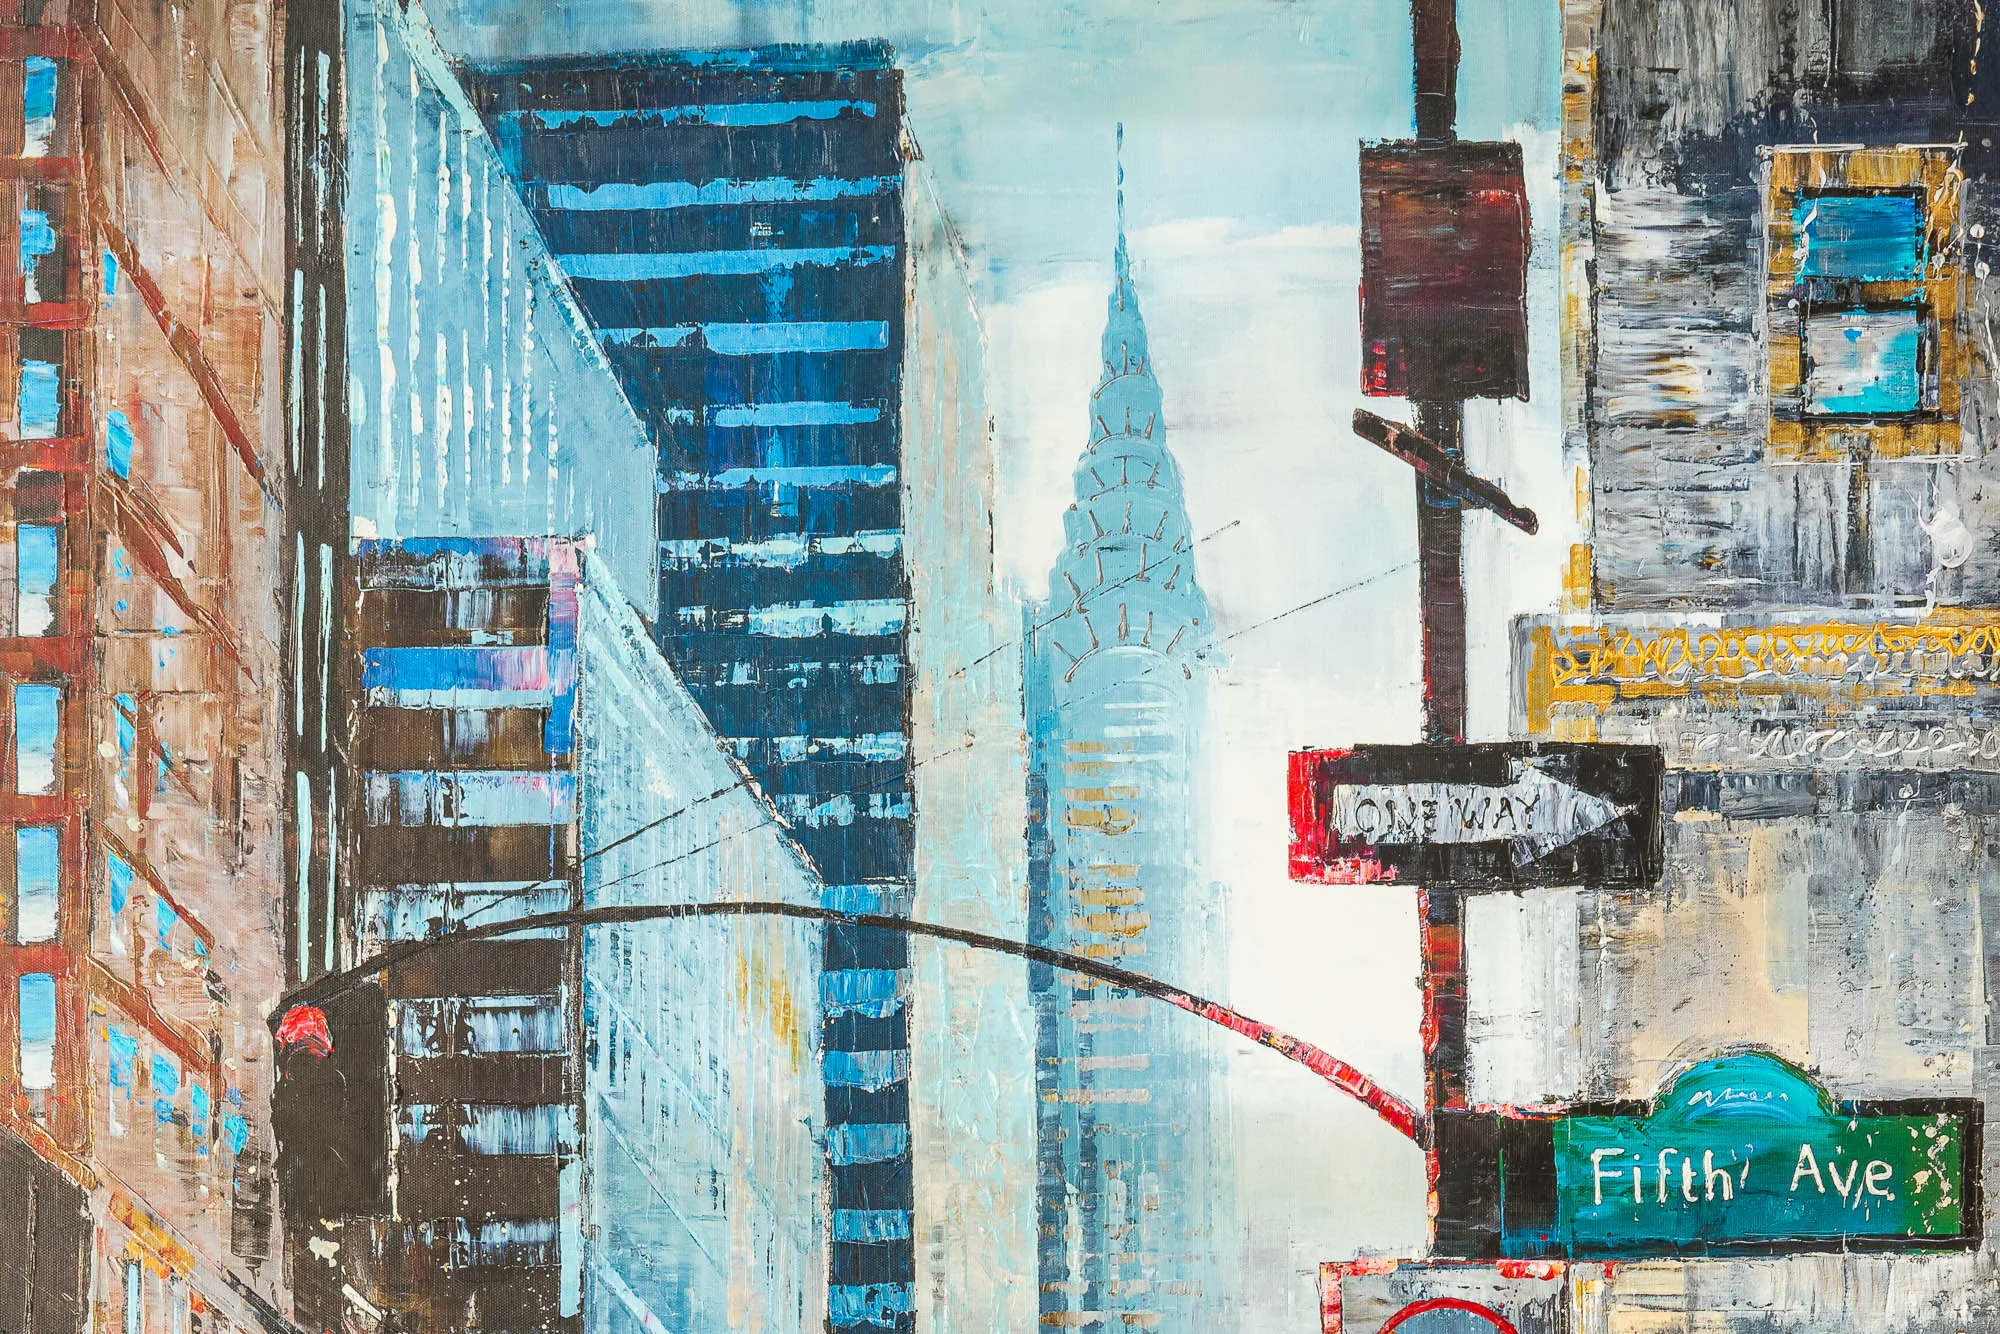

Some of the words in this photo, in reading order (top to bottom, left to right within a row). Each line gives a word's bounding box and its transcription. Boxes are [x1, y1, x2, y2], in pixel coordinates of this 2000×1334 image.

[1355, 797, 1438, 834] ONE
[1454, 794, 1541, 831] WAY
[1589, 1146, 1734, 1206] Fifth
[1789, 1143, 1896, 1202] Ave
